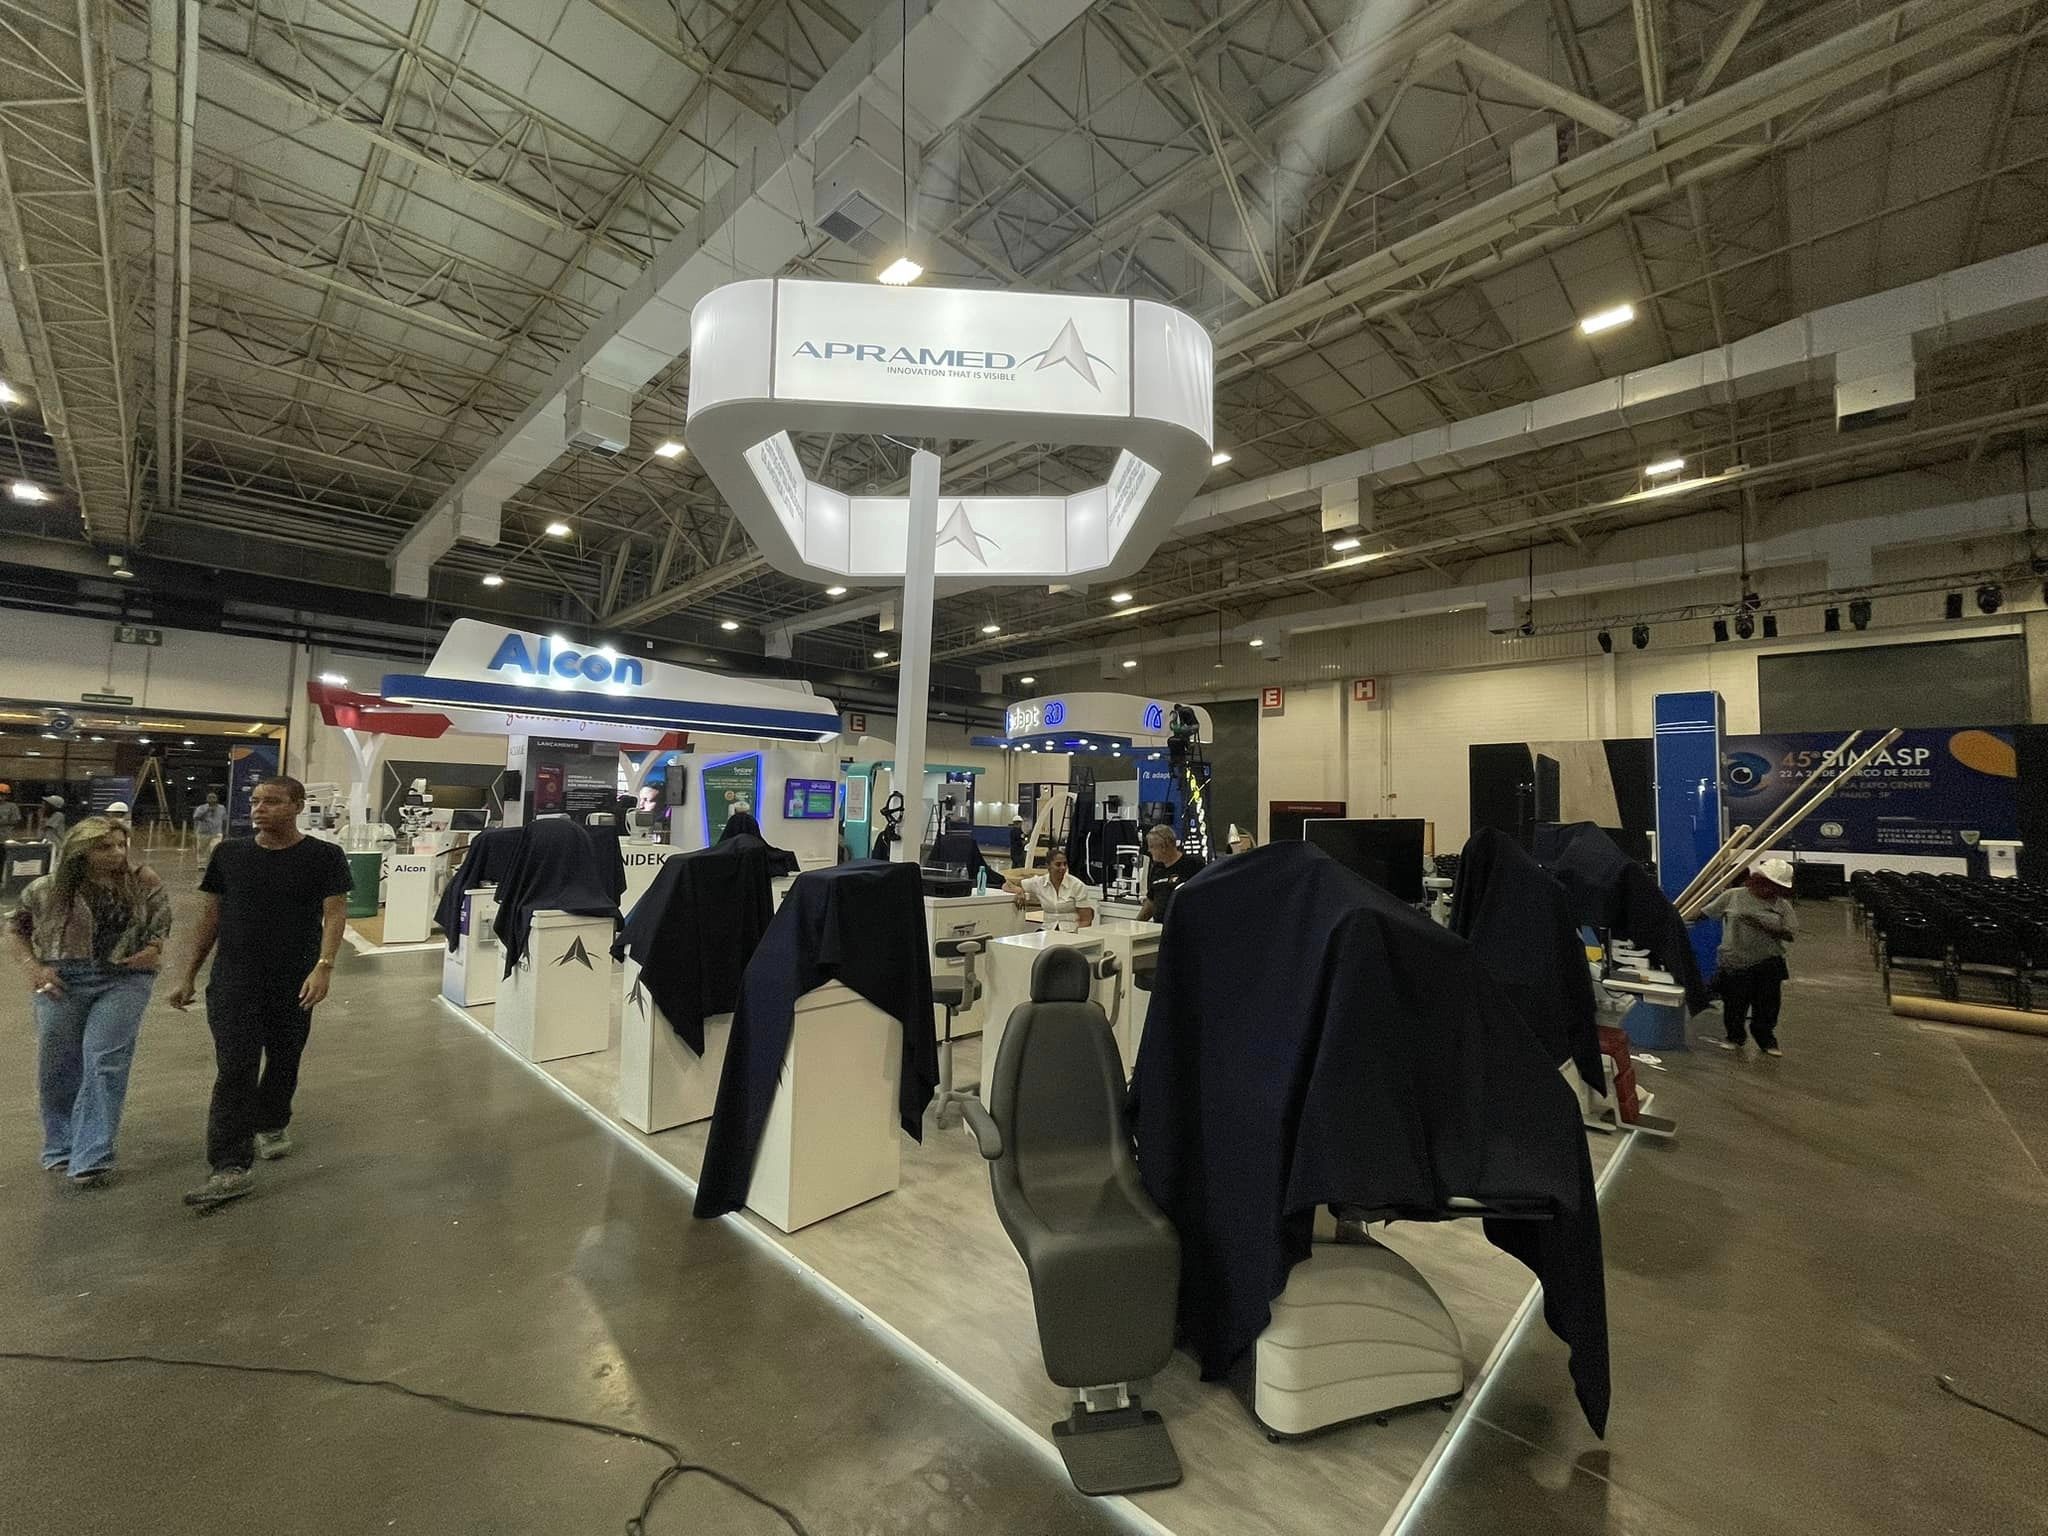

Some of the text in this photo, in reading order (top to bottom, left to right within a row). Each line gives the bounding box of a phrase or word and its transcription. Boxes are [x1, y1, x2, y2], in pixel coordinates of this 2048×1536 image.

[792, 341, 1016, 369] APRAMED
[887, 366, 1016, 381] INNOVATION THAT IS VISIBLE
[487, 633, 643, 686] Alcon
[1265, 689, 1278, 705] E
[1357, 681, 1373, 698] H
[853, 715, 864, 730] E
[1822, 748, 1930, 767] SIMASP
[1822, 769, 1835, 777] DE
[1884, 769, 1899, 777] DE
[1902, 768, 1931, 777] 2023
[621, 853, 666, 866] NIDEK
[395, 864, 426, 873] Alcon
